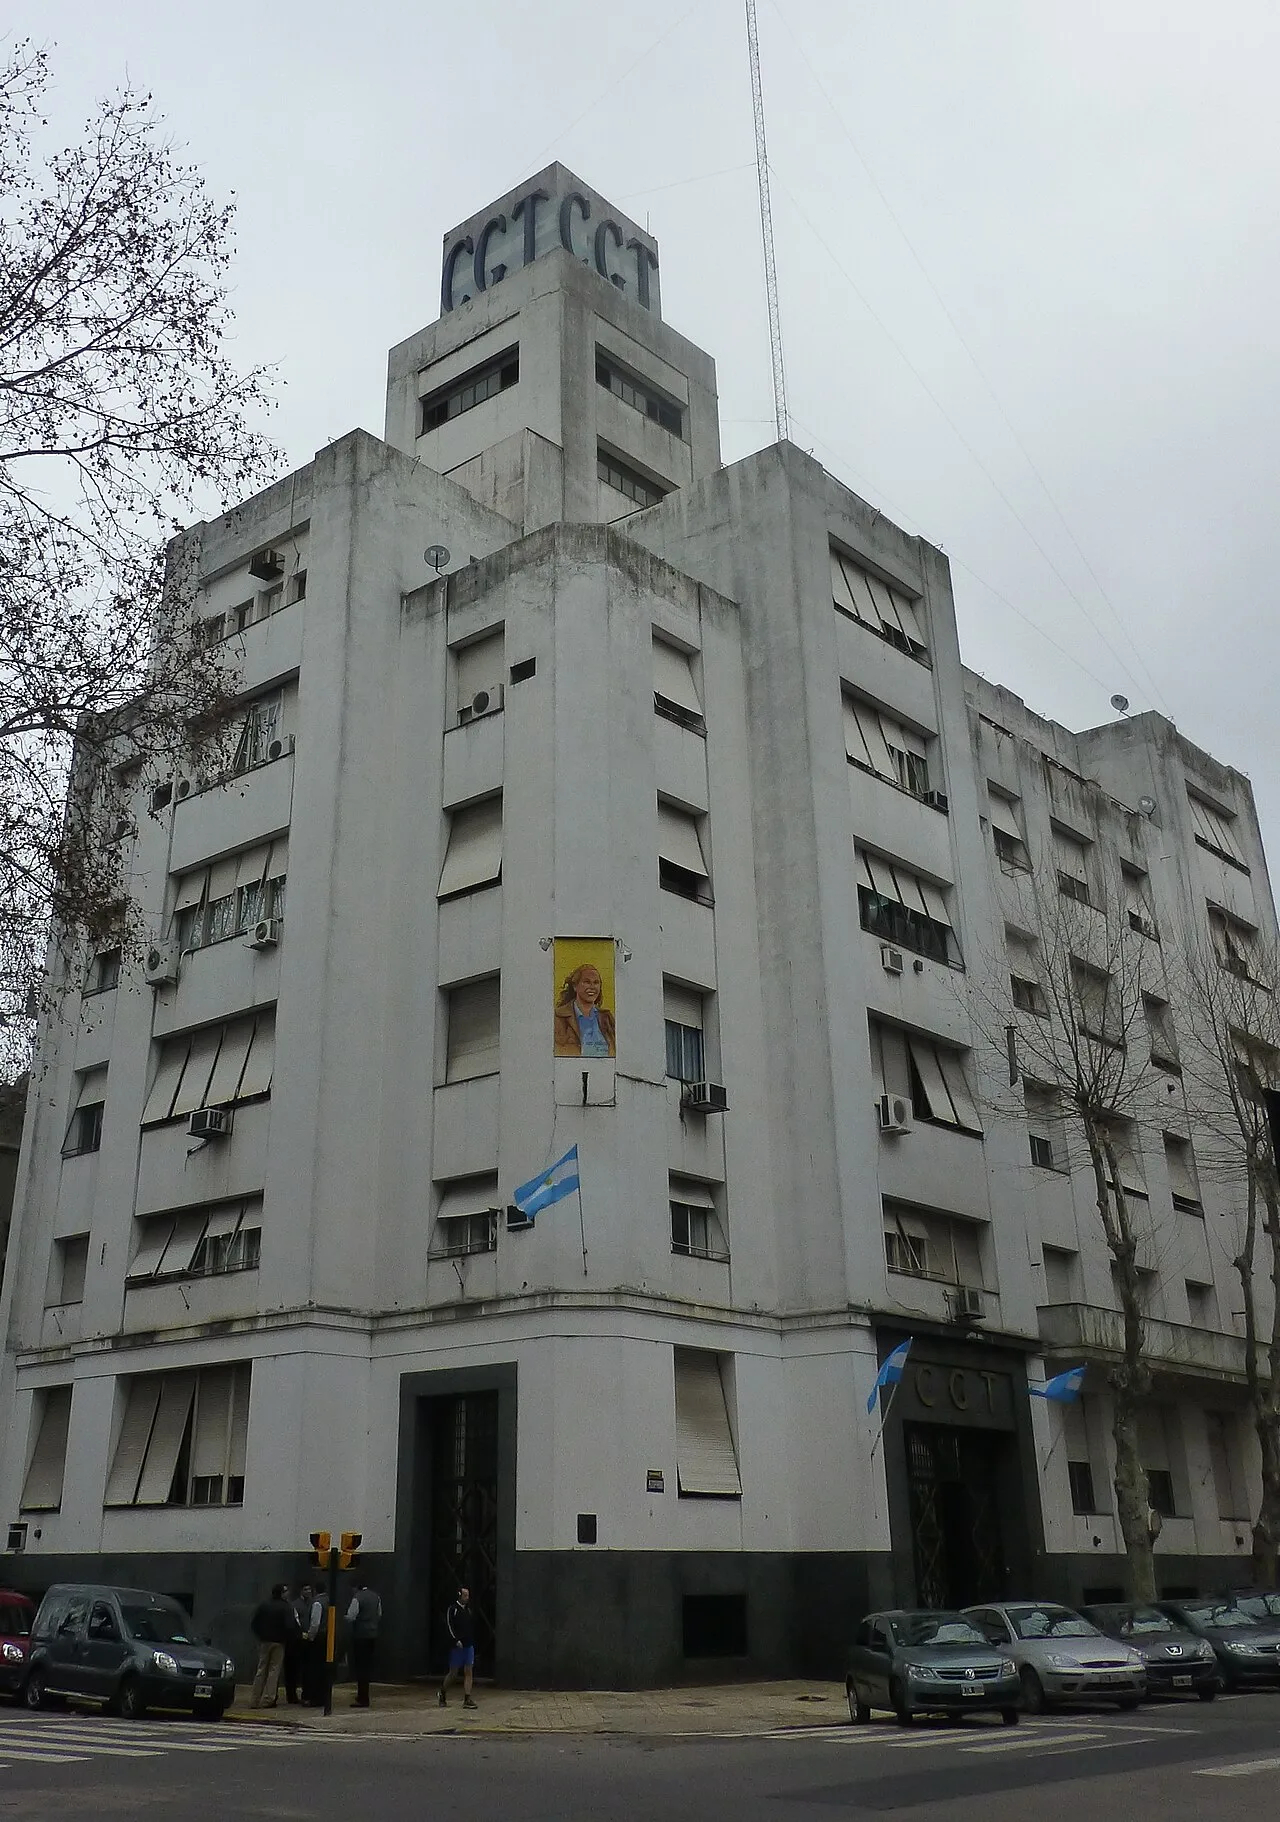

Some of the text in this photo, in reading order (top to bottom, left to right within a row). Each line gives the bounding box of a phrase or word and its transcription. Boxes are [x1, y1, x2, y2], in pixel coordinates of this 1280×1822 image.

[442, 188, 549, 313] CGT
[560, 192, 658, 311] CGT
[914, 1366, 997, 1415] CGT
